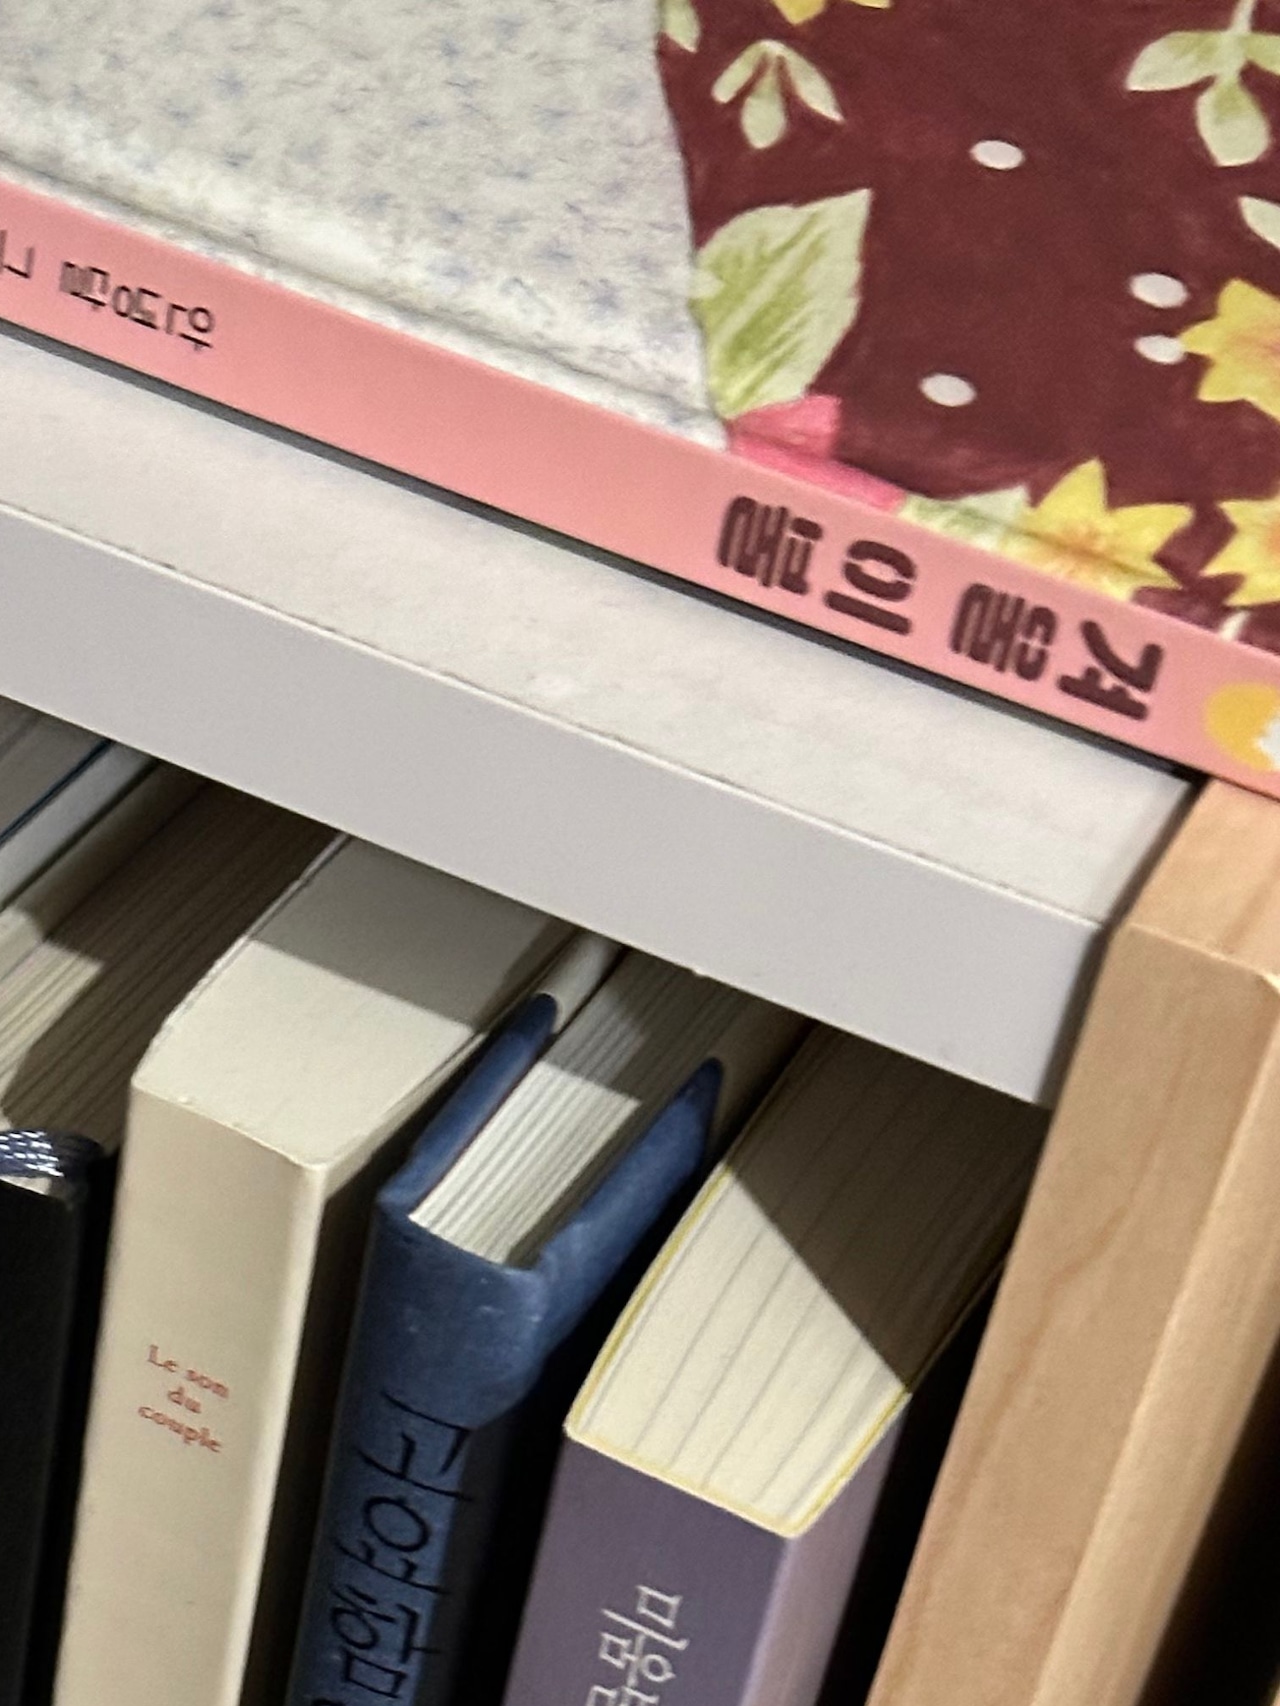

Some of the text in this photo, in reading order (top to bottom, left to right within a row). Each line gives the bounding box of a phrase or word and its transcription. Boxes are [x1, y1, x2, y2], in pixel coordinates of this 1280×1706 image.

[57, 259, 218, 353] 안녕달
[715, 493, 1166, 723] 겨울 이불
[146, 1343, 231, 1400] Le son
[166, 1385, 203, 1415] du
[137, 1405, 223, 1454] couple
